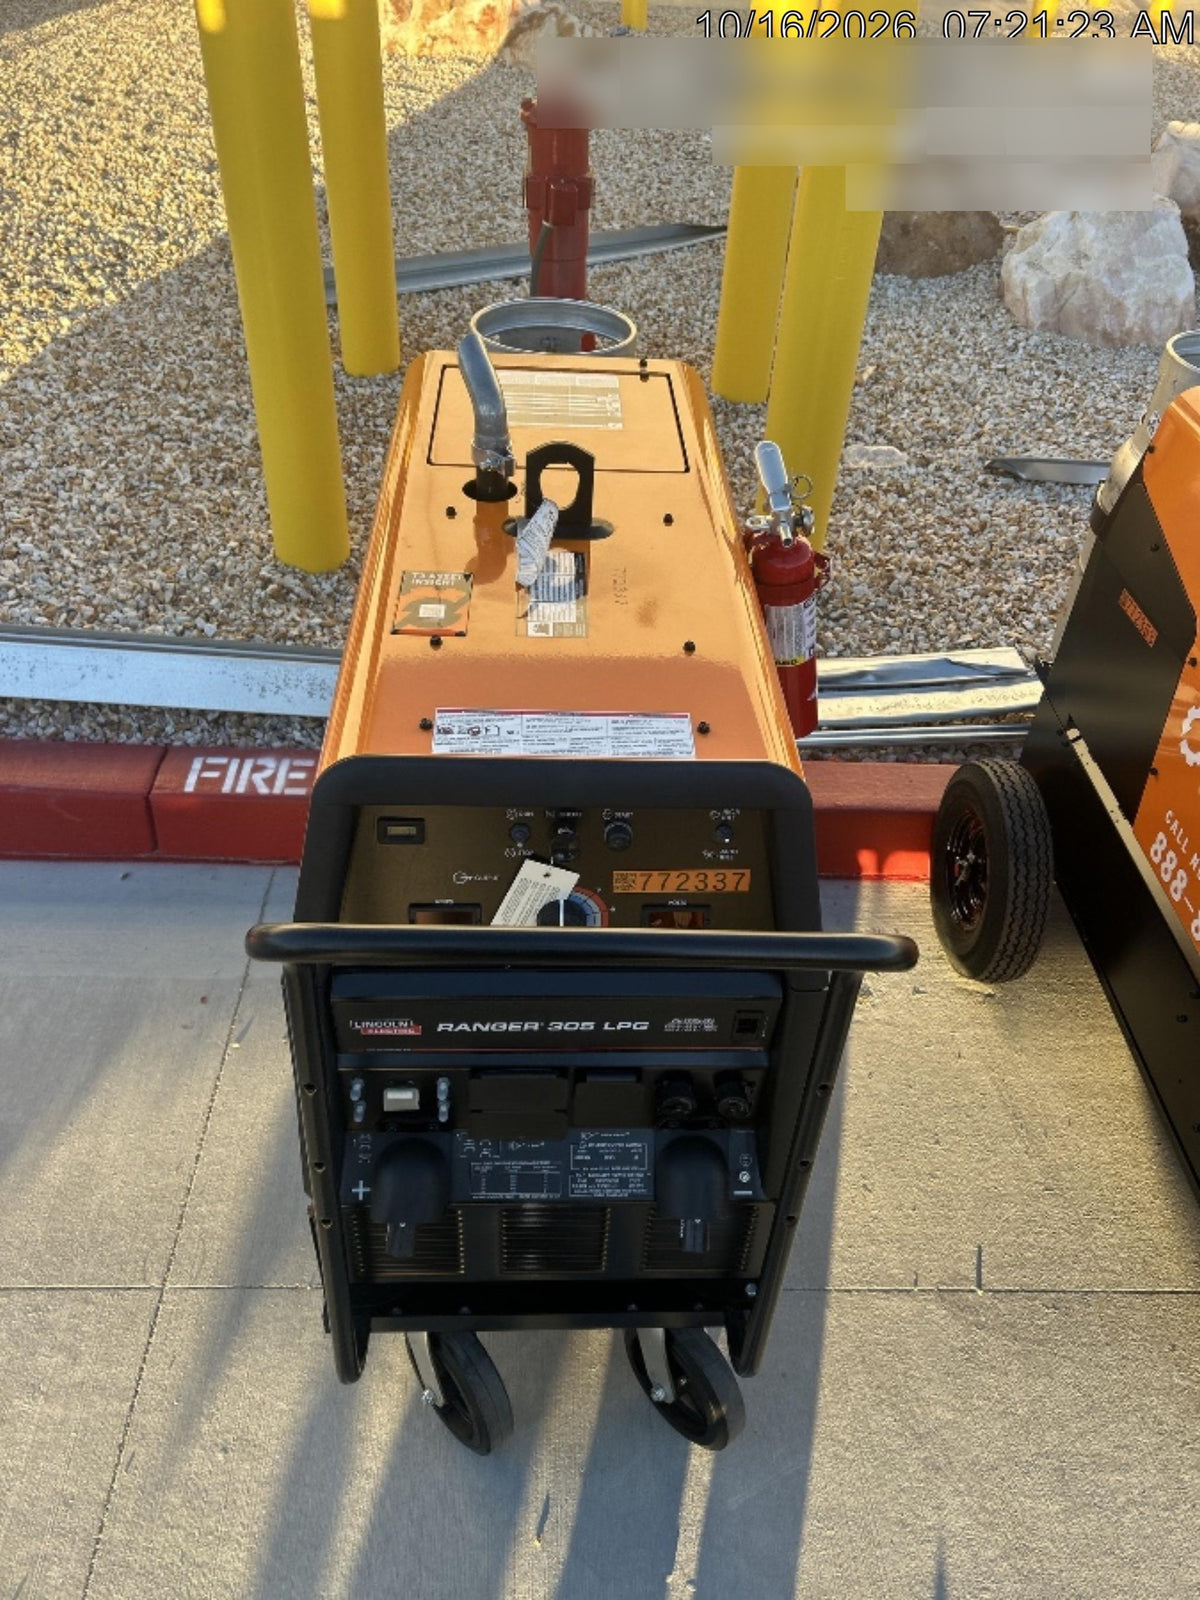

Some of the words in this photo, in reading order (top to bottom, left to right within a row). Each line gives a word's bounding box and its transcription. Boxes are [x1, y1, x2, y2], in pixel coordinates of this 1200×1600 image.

[183, 756, 315, 796] FIRE
[1165, 809, 1189, 854] CALL
[639, 872, 746, 891] 772337
[547, 1021, 597, 1033] 305
[603, 1021, 651, 1032] LPG
